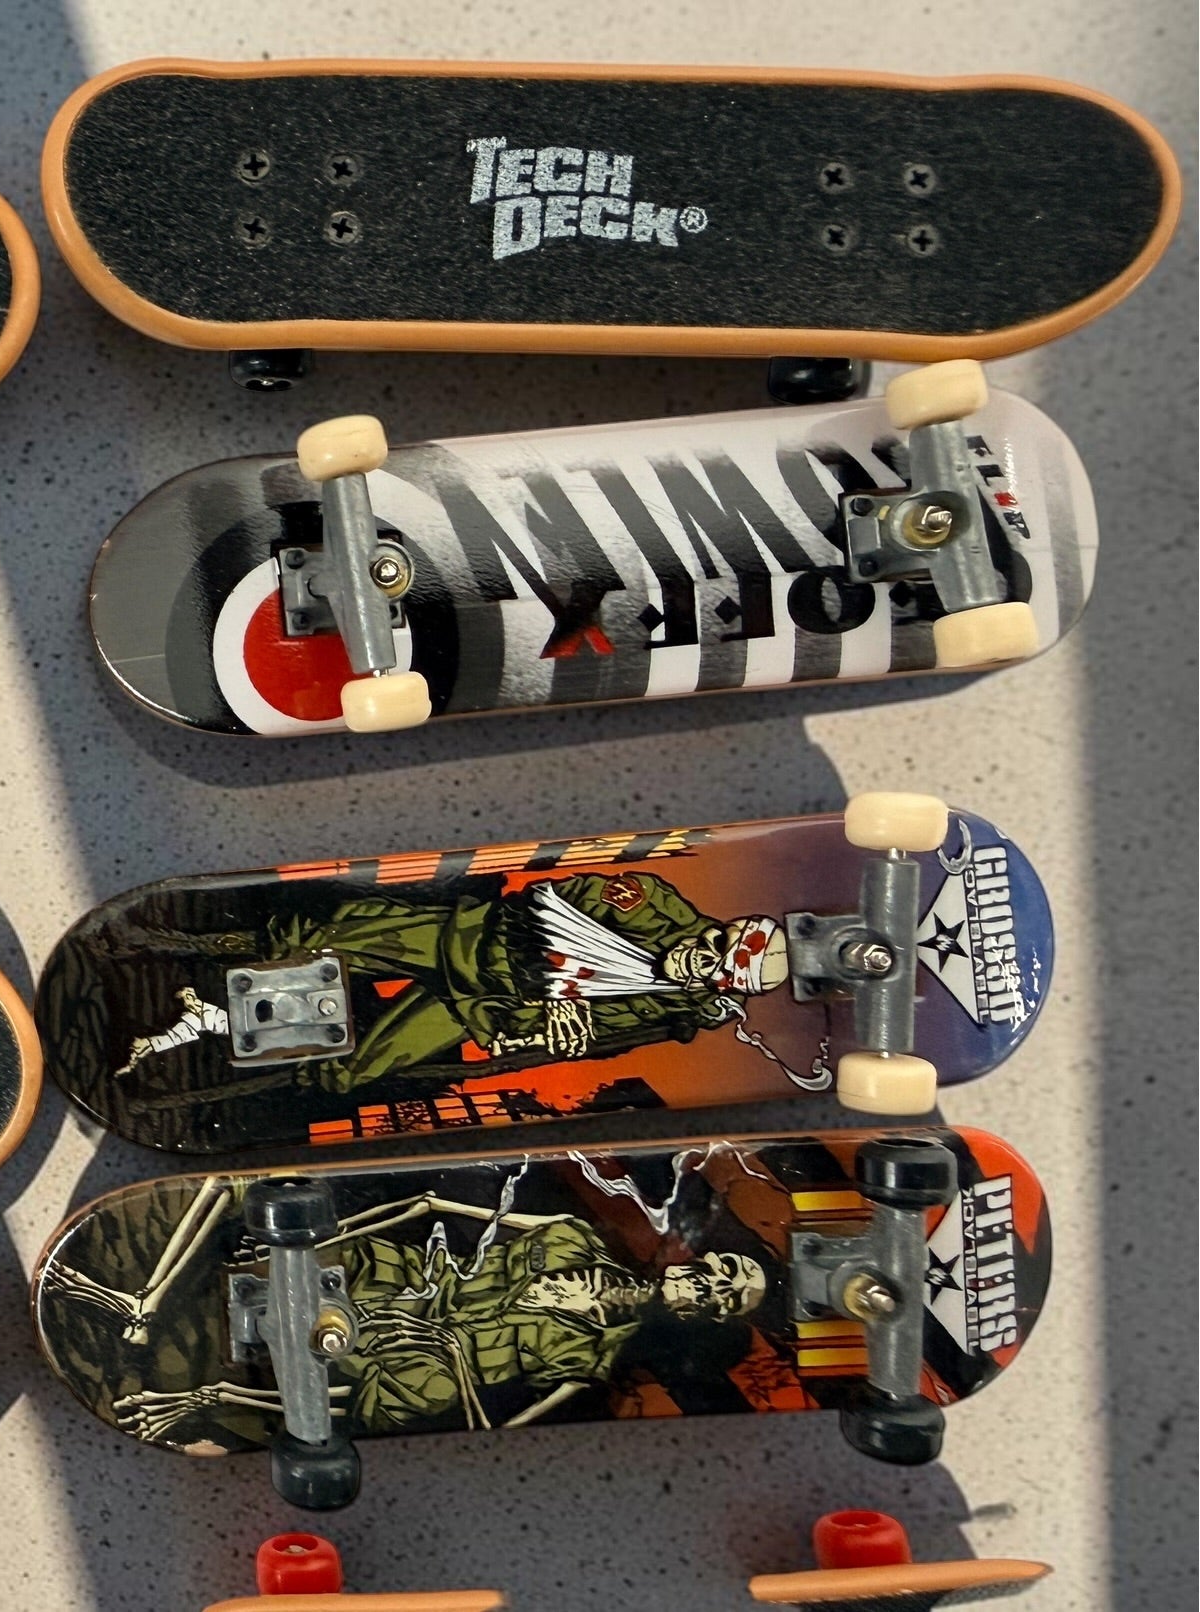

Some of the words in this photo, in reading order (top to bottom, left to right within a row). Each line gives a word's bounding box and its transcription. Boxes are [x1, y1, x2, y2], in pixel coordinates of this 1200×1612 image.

[466, 136, 634, 204] TECH
[962, 862, 983, 941] BLAC
[973, 1175, 1018, 1352] PETERS
